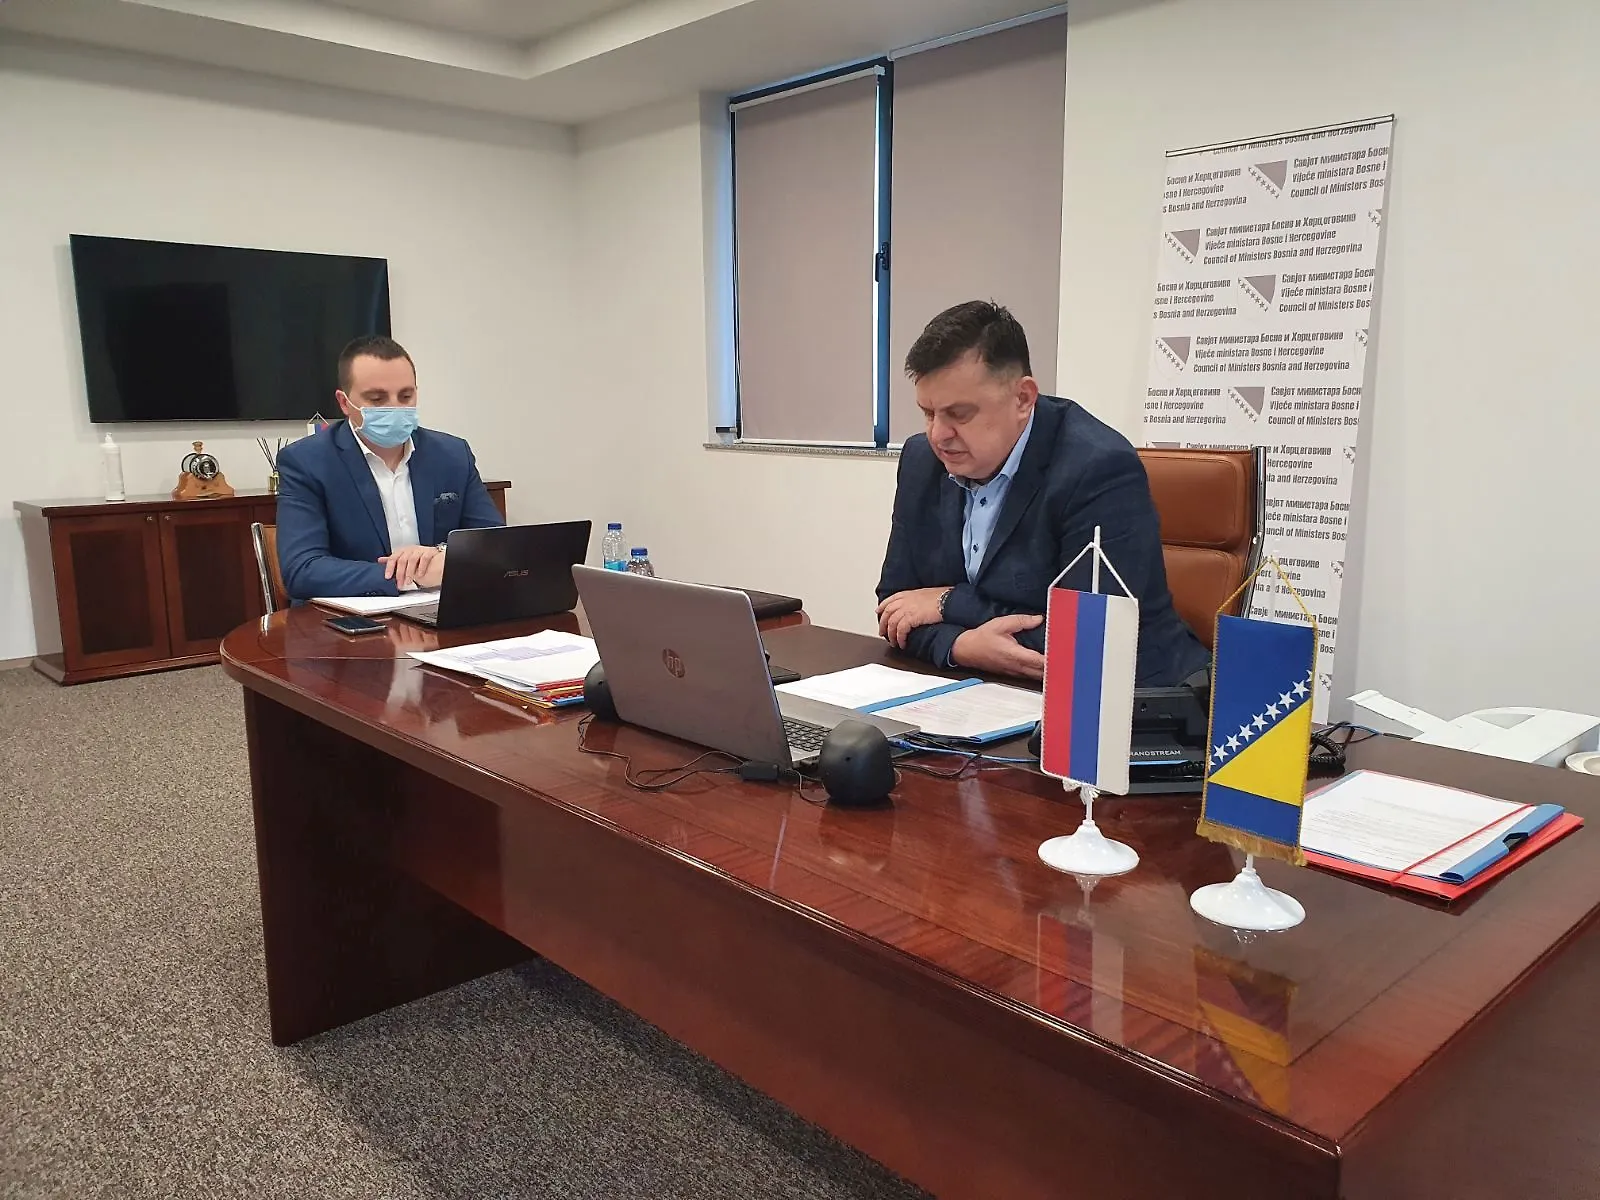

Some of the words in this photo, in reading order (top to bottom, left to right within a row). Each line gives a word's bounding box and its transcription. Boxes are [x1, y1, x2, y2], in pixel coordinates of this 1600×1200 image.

[1318, 166, 1354, 179] ministara
[1356, 163, 1380, 174] Bosne
[1291, 186, 1318, 198] Council
[1321, 186, 1328, 194] of
[1330, 180, 1367, 193] Ministers
[1169, 202, 1190, 212] Bosnia
[1192, 201, 1204, 210] and
[1206, 196, 1246, 208] Herzegovina
[1227, 238, 1260, 248] ministara
[1262, 236, 1283, 245] Bosne
[1289, 230, 1336, 242] Hercegovine
[1204, 255, 1228, 264] Council
[1230, 254, 1236, 262] of
[1239, 251, 1271, 261] Ministers
[1273, 248, 1297, 259] Bosnia
[1299, 247, 1313, 256] and
[1315, 243, 1362, 255] Herzegovina
[1306, 286, 1341, 296] ministara
[1344, 284, 1367, 294] Bosne
[1174, 293, 1214, 304] Hercegovine
[1159, 310, 1180, 318] Bosnia
[1182, 309, 1194, 317] and
[1196, 306, 1236, 317] Herzegovina
[1280, 302, 1307, 312] Council
[1309, 302, 1316, 311] of
[1318, 300, 1353, 310] Ministers
[1217, 348, 1249, 357] ministara
[1251, 348, 1272, 356] Bosne
[1278, 346, 1324, 356] Hercegovine
[1194, 363, 1218, 372] Council
[1220, 363, 1226, 372] of
[1228, 362, 1260, 372] Ministers
[1262, 362, 1286, 371] Bosnia
[1288, 362, 1302, 370] and
[1304, 361, 1350, 371] Herzegovina
[1164, 401, 1204, 410] Hercegovine
[1294, 401, 1329, 410] ministara
[1332, 401, 1354, 410] Bosne
[1150, 415, 1171, 423] Bosnia
[1186, 415, 1226, 424] Herzegovina
[1268, 416, 1295, 425] Council
[1297, 416, 1305, 425] of
[1307, 416, 1341, 425] Ministers
[1267, 459, 1313, 468] Hercegovine
[1293, 475, 1337, 485] Herzegovina
[1283, 512, 1317, 523] ministara
[1320, 515, 1342, 525] Bosne
[1266, 527, 1284, 536] uncil
[1295, 528, 1330, 539] Ministers
